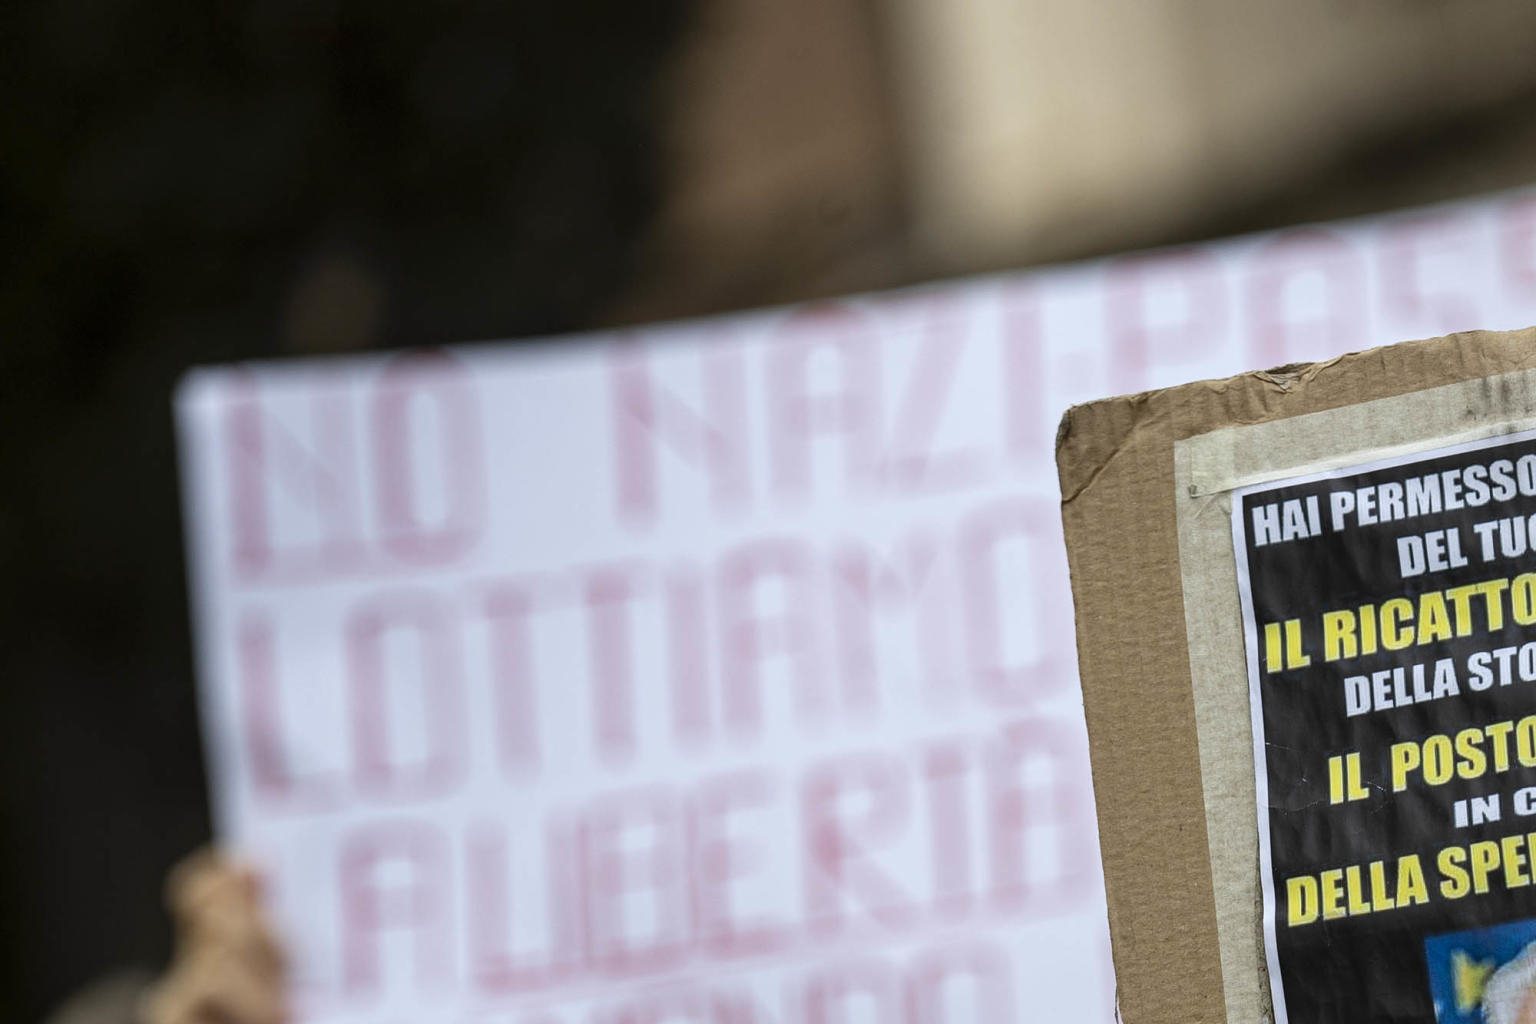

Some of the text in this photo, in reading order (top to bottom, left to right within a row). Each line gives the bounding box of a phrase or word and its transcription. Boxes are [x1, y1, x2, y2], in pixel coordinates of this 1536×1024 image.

[1251, 495, 1322, 547] HAI
[1396, 527, 1469, 579] DEL
[235, 497, 1085, 815] LOTTIAMO
[1264, 618, 1311, 674] IL
[1343, 657, 1460, 718] DELLA
[1328, 751, 1370, 806] IL
[1453, 793, 1501, 829] IN
[1286, 854, 1430, 928] DELLA
